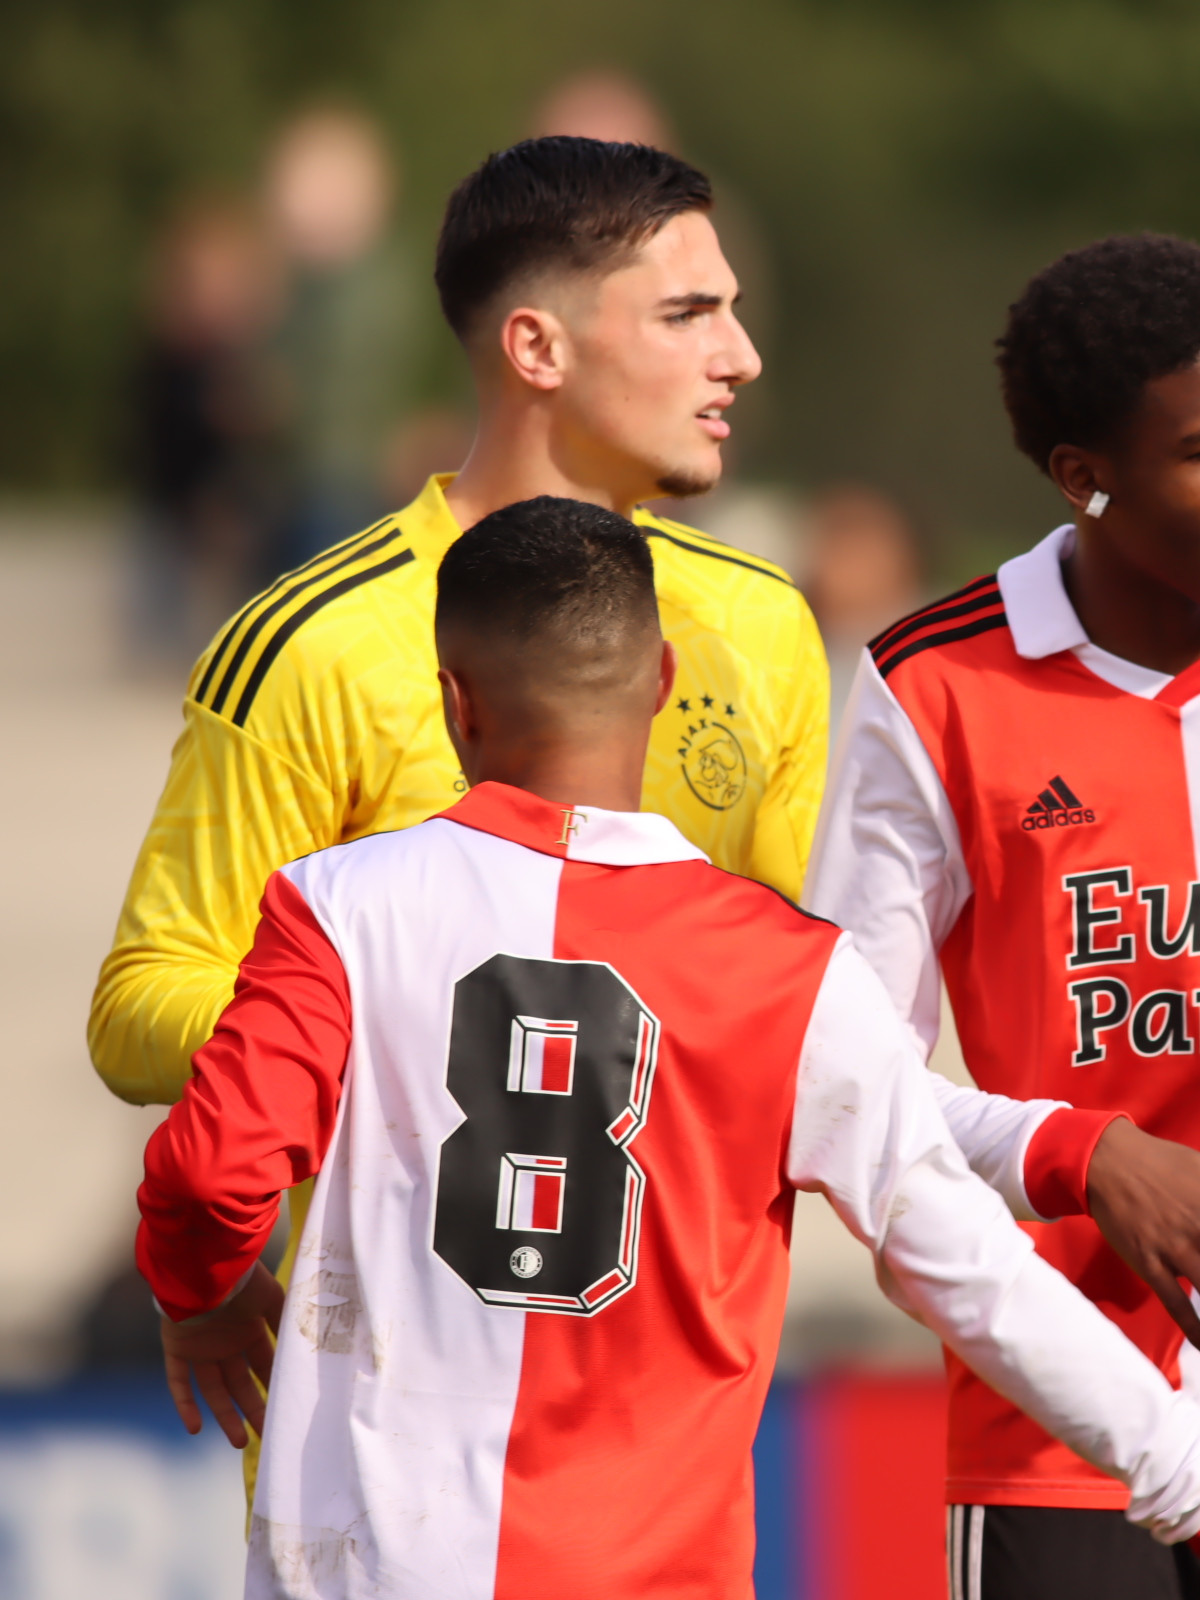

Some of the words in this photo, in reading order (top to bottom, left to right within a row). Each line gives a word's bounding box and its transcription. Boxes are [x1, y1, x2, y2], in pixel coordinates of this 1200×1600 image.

[677, 718, 708, 759] AJAX
[553, 809, 588, 846] F
[1021, 808, 1096, 831] adidas
[432, 952, 661, 1318] 8
